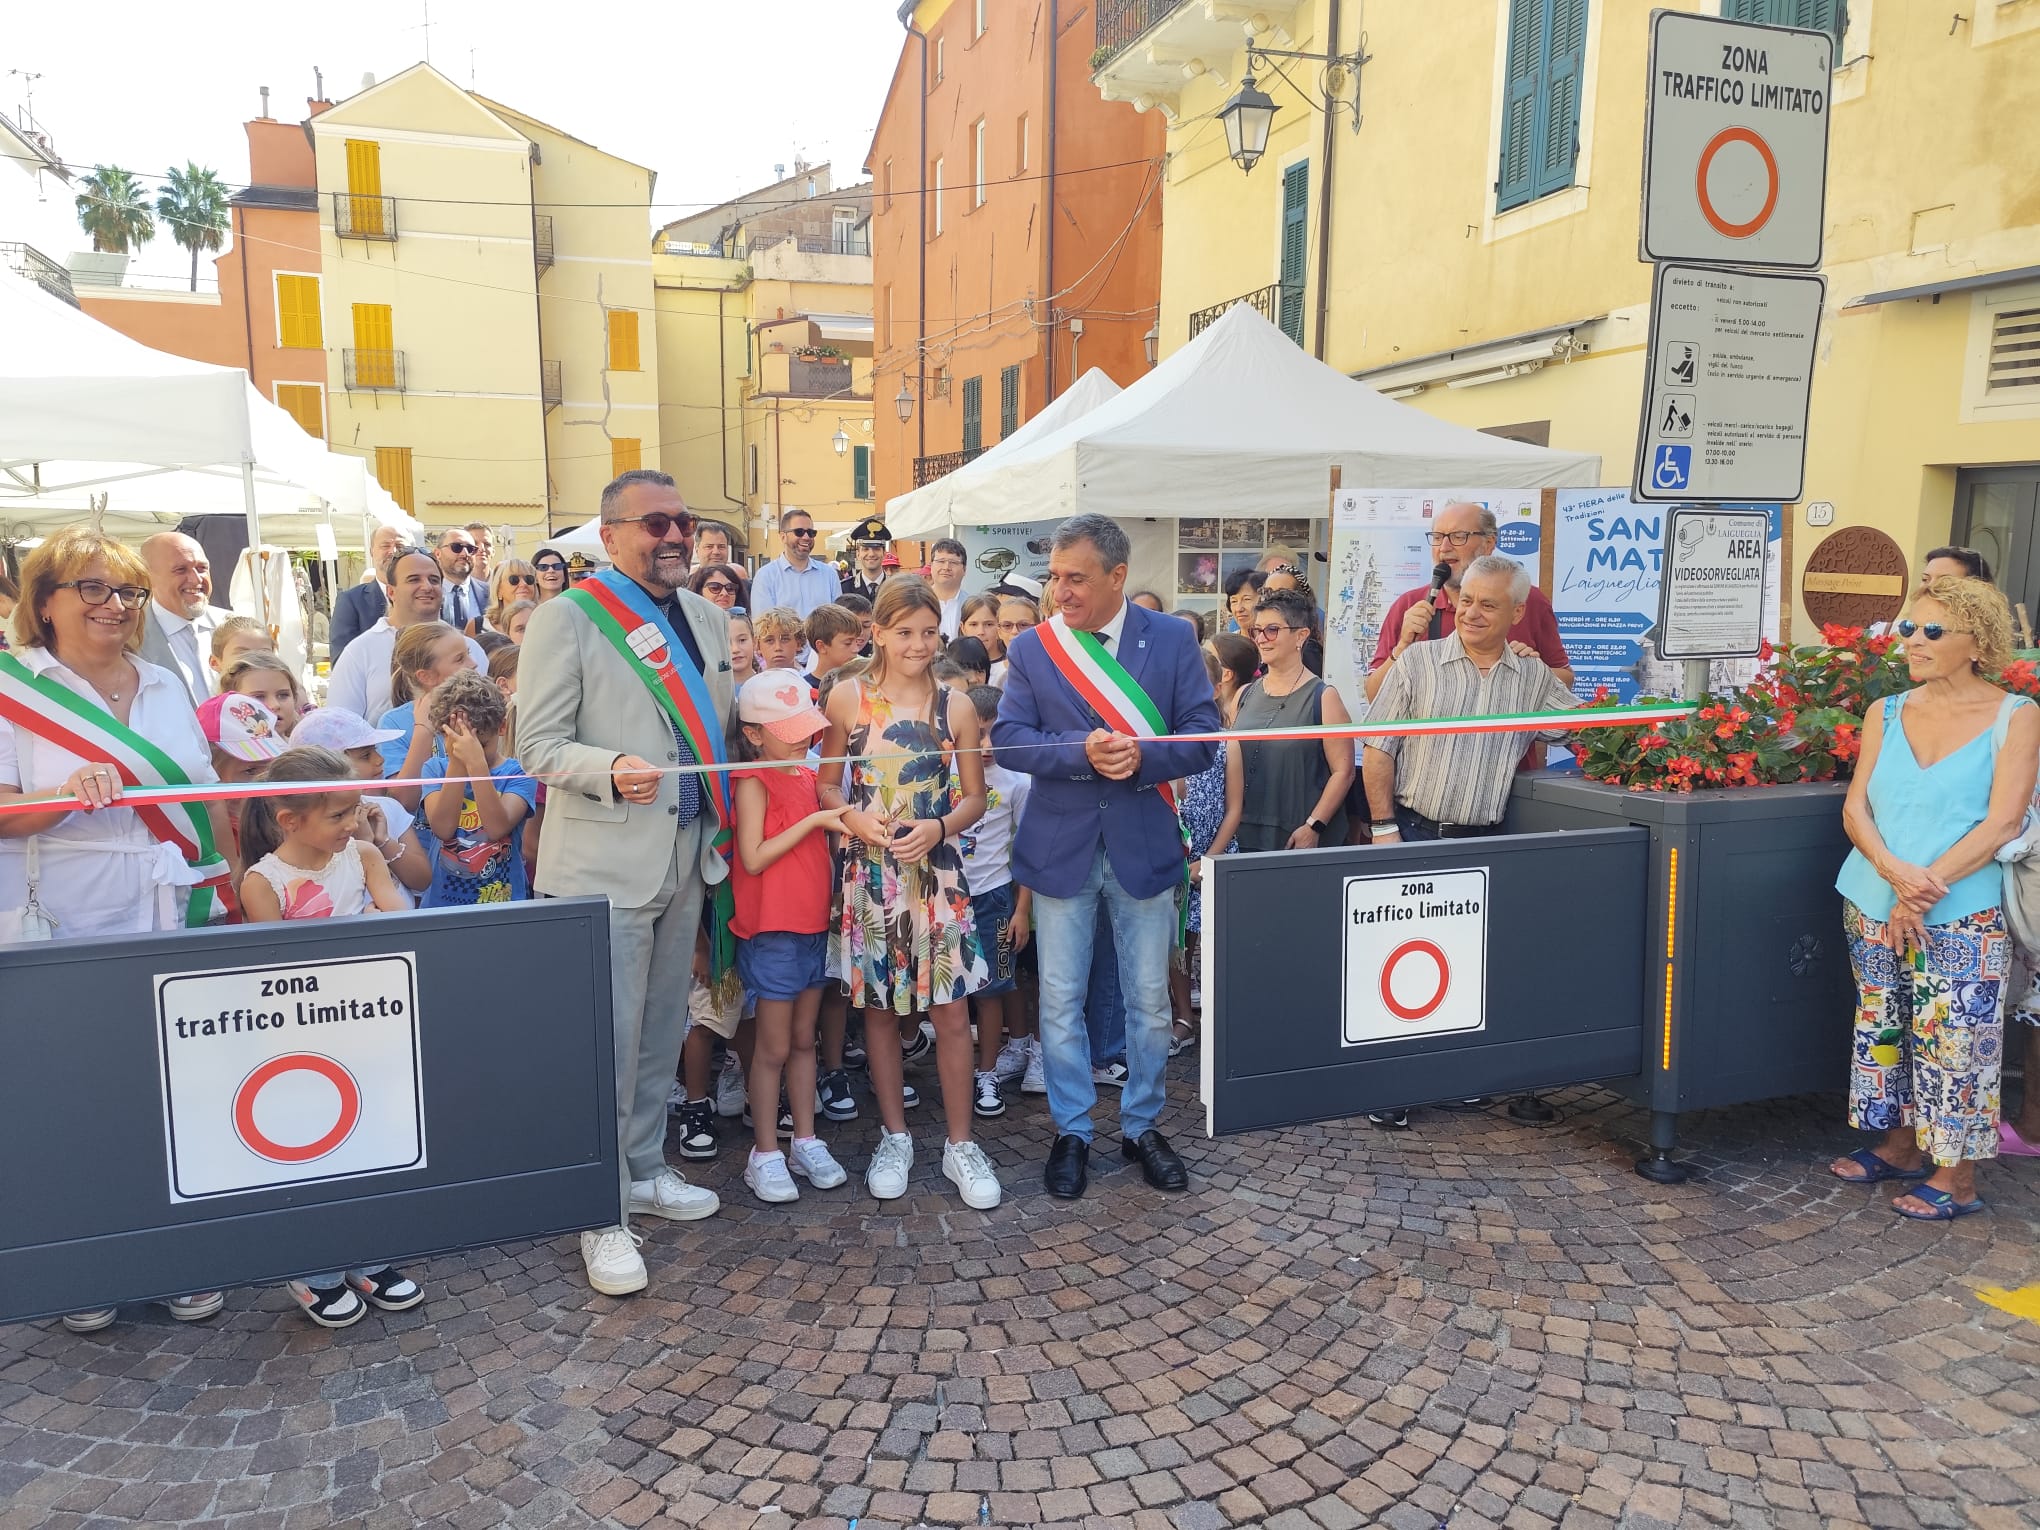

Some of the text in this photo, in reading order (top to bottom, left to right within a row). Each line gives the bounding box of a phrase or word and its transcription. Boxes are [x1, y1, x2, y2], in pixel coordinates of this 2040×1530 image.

[1721, 44, 1768, 75] ZONA
[1662, 71, 1823, 114] TRAFFICO LIMITATO
[1672, 277, 1694, 287] divieto
[1705, 280, 1727, 291] transito
[1670, 303, 1700, 312] eccetto:
[1773, 331, 1804, 339] settimanale
[1578, 497, 1605, 510] FIERA
[1606, 493, 1626, 503] delle
[1564, 508, 1605, 522] Tradizioni
[1813, 506, 1827, 519] 15
[1587, 516, 1660, 542] SAN
[1728, 518, 1763, 527] Comune di
[1718, 529, 1761, 538] LAIGUEGLIA
[1727, 540, 1761, 560] AREA
[1586, 545, 1664, 573] MAT
[1674, 567, 1760, 581] VIDEOSORVEGLIATA
[1401, 881, 1434, 897] zona
[1352, 899, 1480, 925] traffico limitato
[996, 917, 1011, 980] SONIC
[261, 975, 319, 997] zona
[175, 995, 404, 1039] traffico limitato
